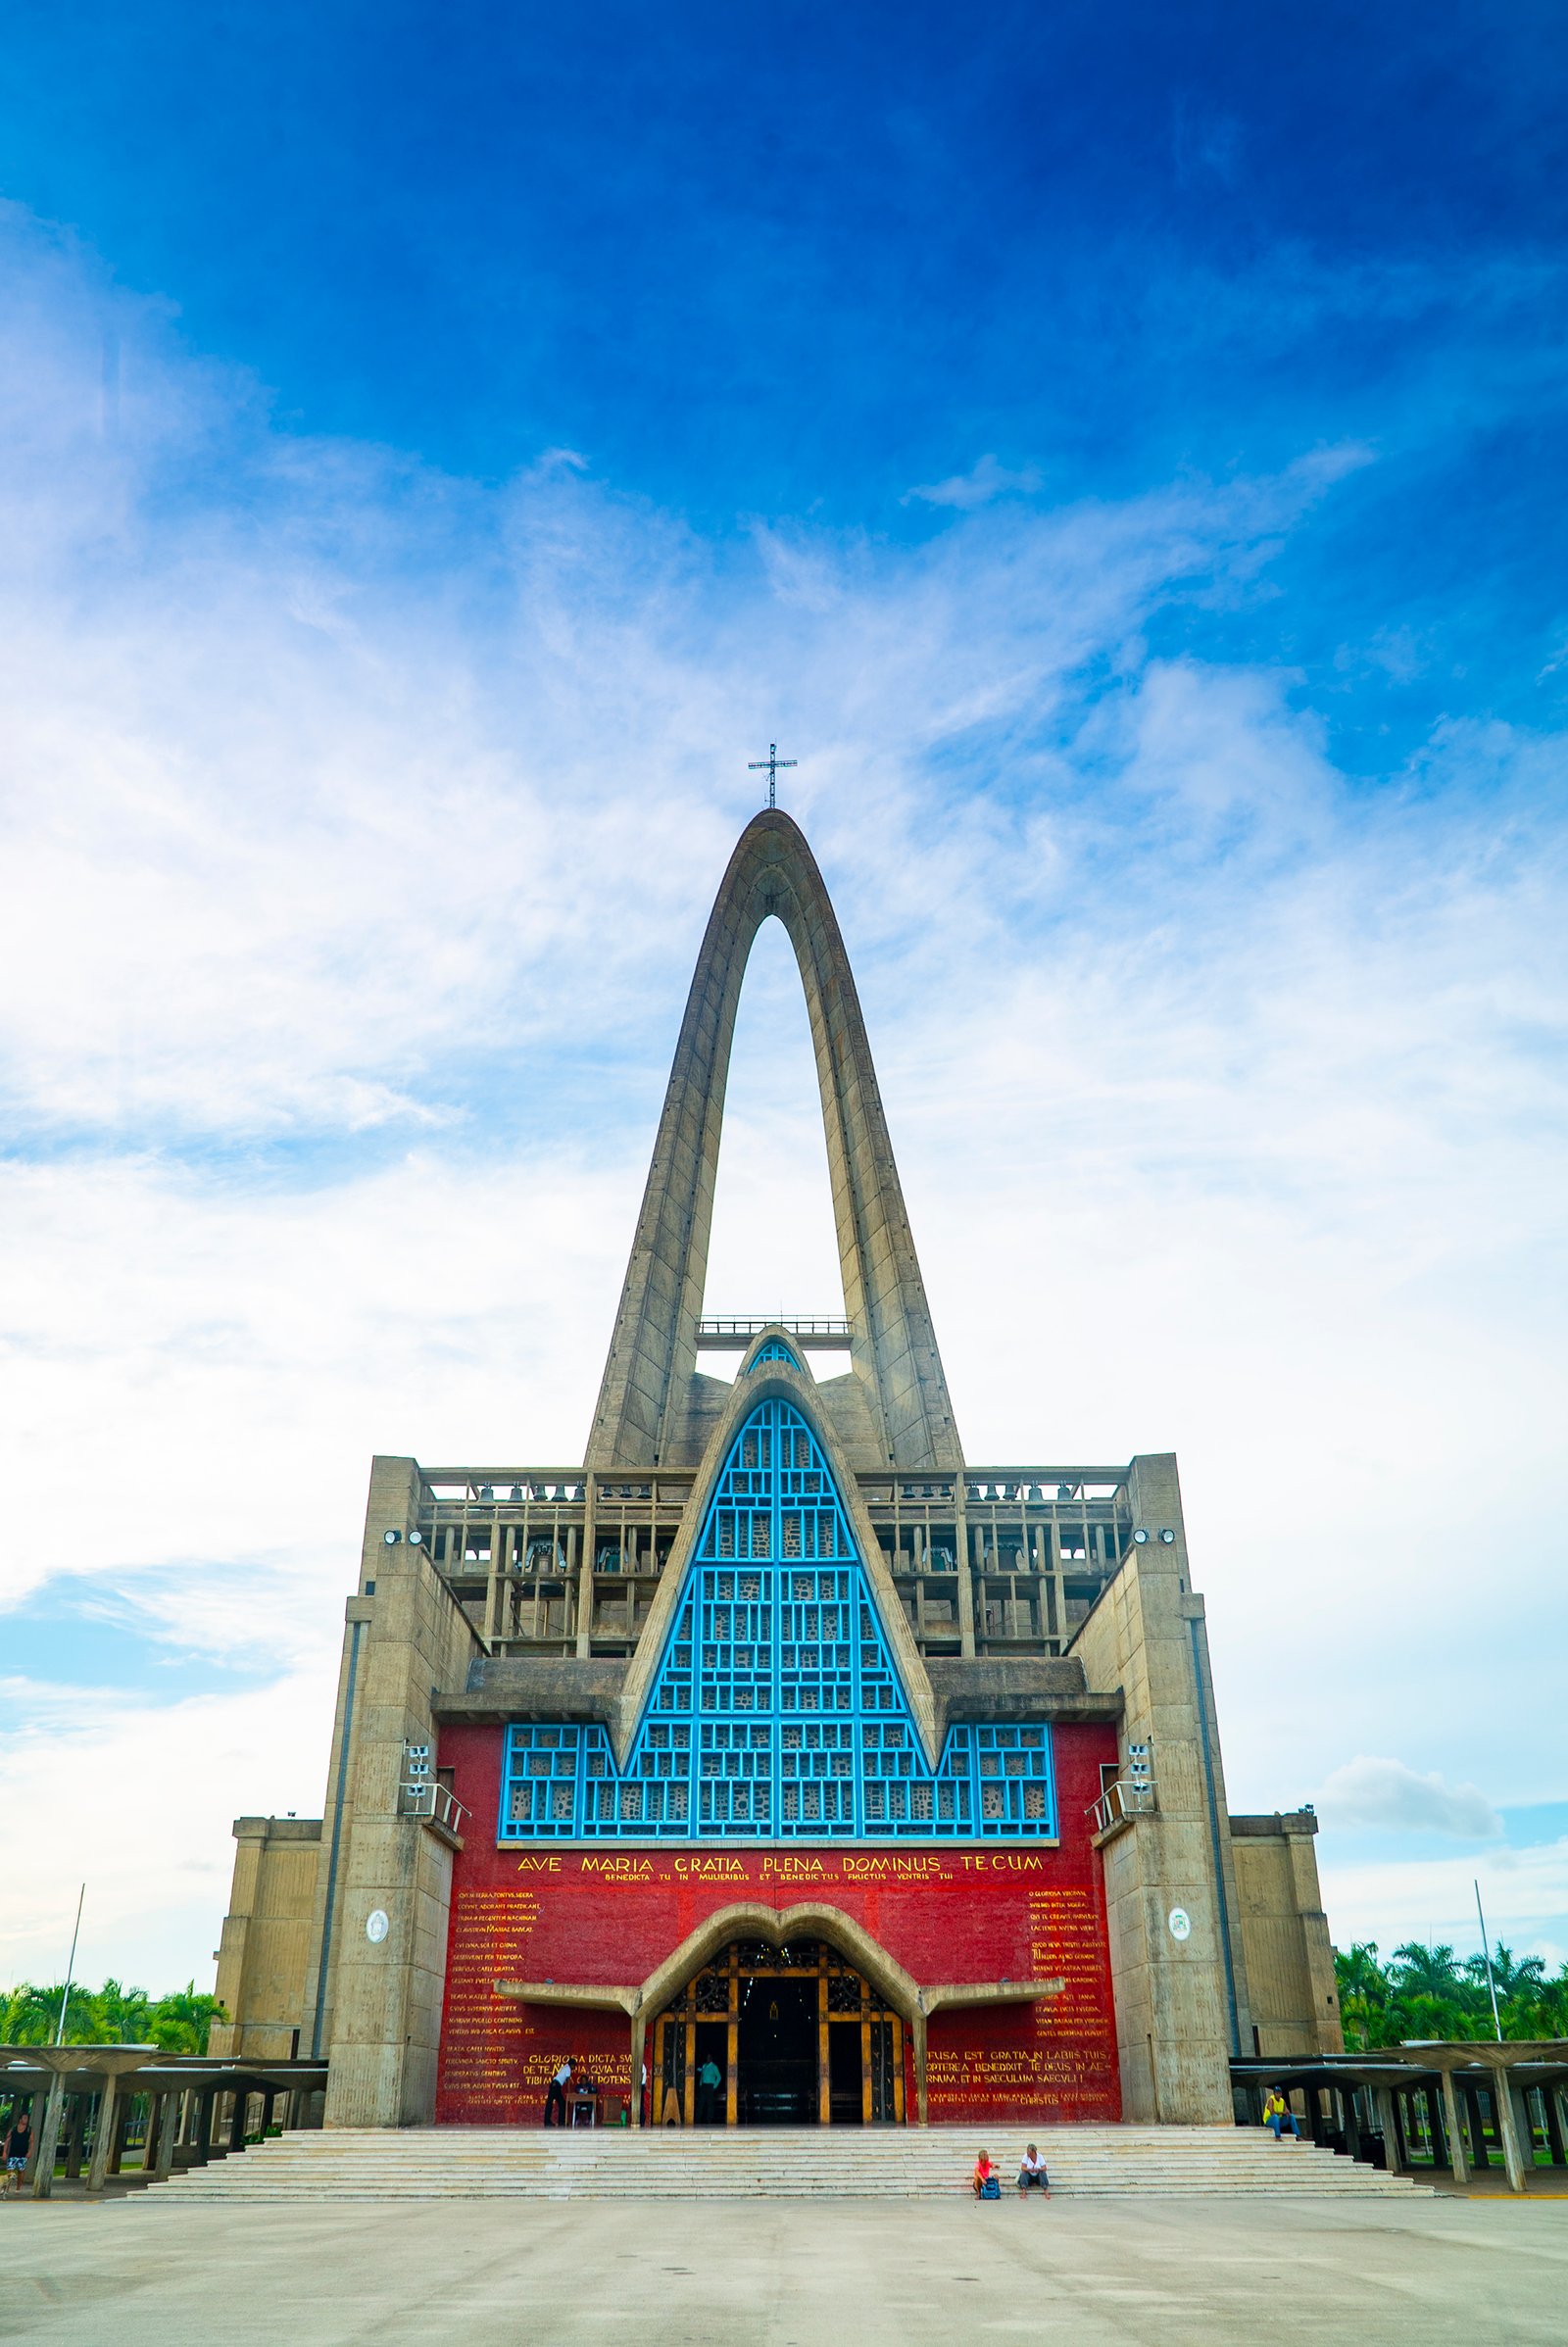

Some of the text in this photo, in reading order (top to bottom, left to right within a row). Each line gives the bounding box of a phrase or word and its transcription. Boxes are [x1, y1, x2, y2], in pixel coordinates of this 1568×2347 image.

[517, 1855, 1043, 1872] AVE MARIA GRATIA PLENA DOMINUS TECUM
[589, 2054, 616, 2063] DICTA
[964, 2051, 984, 2060] EST
[990, 2051, 1029, 2060] GRATIA
[1033, 2051, 1043, 2060] IN
[522, 2066, 536, 2075] DE
[590, 2065, 613, 2075] QVIA
[975, 2063, 1022, 2072] BENEDIXIT
[1044, 2062, 1071, 2071] DEUS
[1075, 2062, 1085, 2071] IN
[525, 2077, 543, 2085] TIBI
[960, 2075, 971, 2083] ET
[972, 2075, 981, 2083] IN
[984, 2075, 1034, 2083] SAECULUM
